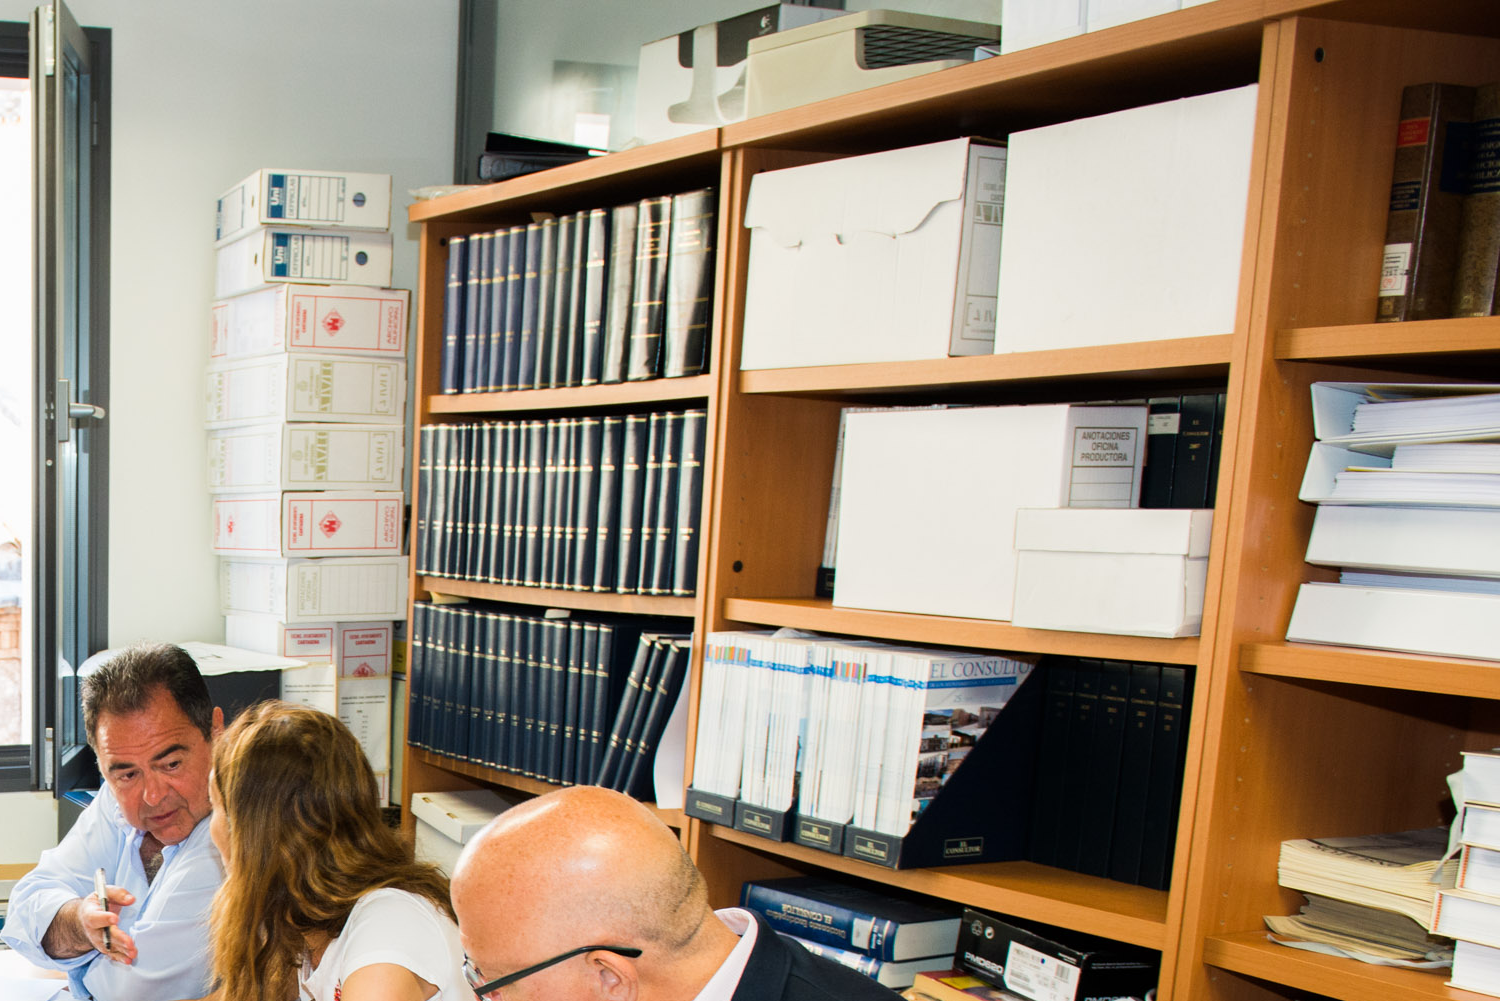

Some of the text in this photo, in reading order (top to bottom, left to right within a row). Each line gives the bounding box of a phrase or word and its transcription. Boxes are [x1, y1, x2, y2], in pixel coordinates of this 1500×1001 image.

[1081, 431, 1131, 441] ANOTACIONES
[1091, 442, 1119, 451] OFICINA
[1080, 452, 1128, 462] PRODUCTORA
[930, 663, 948, 679] EL
[781, 903, 833, 926] EL CONSULTOR
